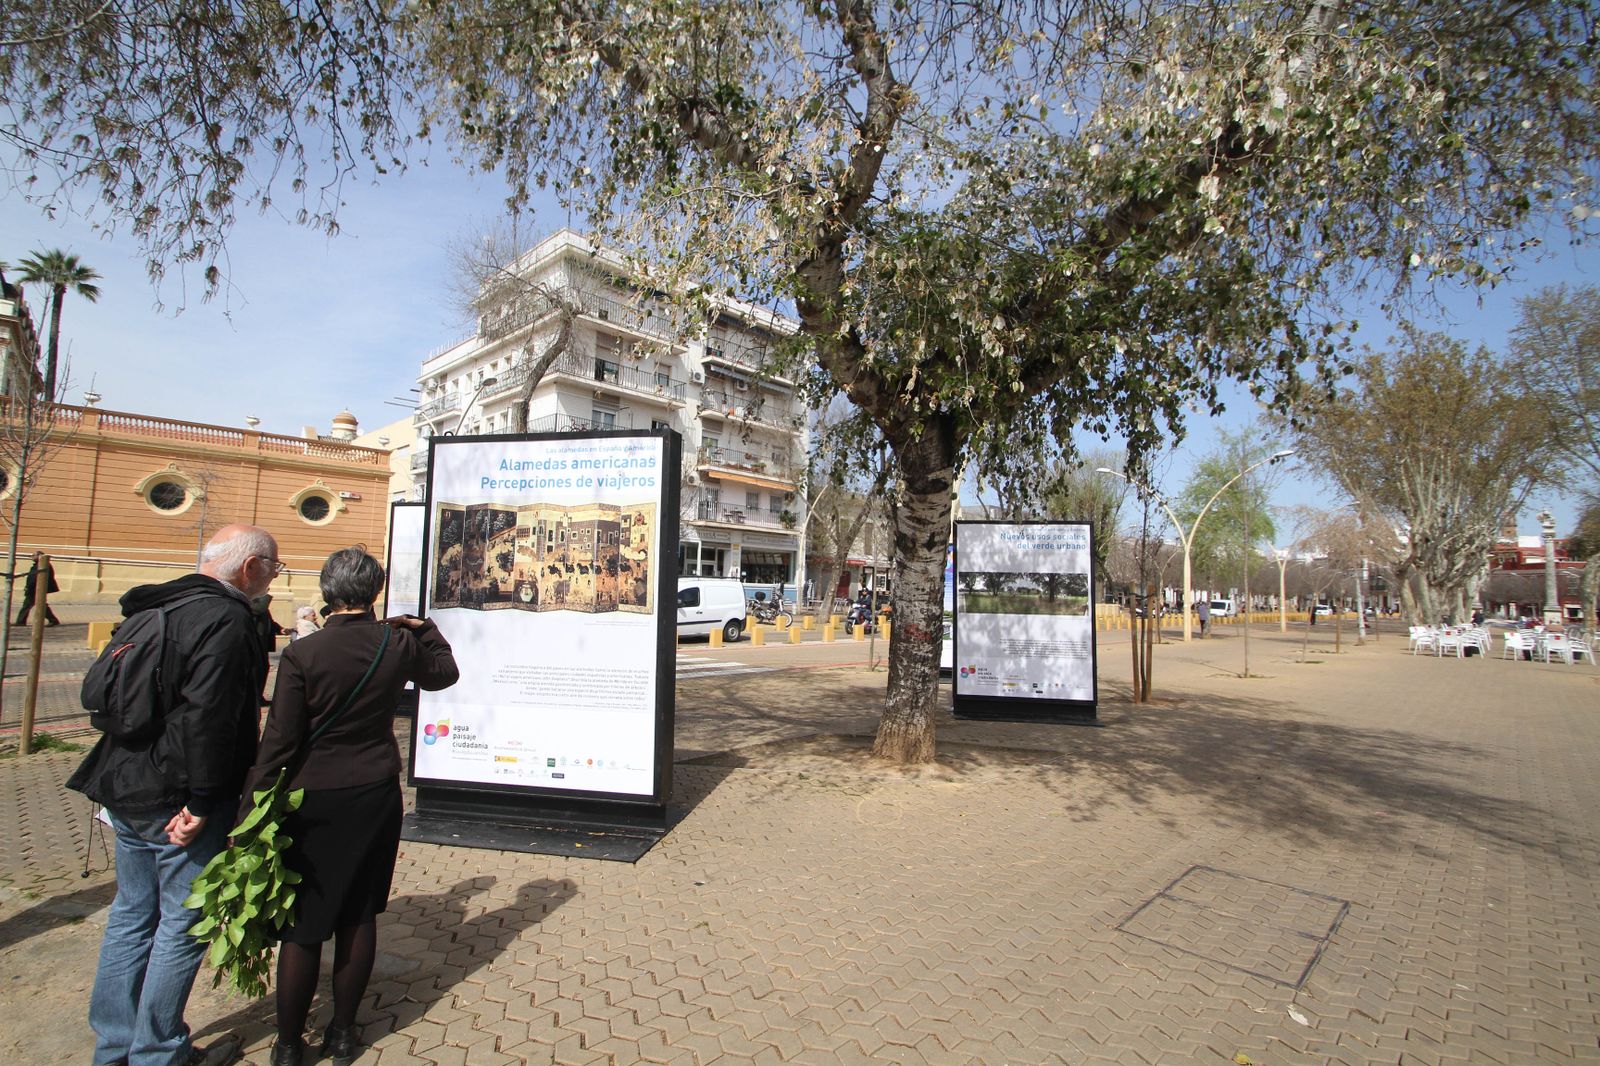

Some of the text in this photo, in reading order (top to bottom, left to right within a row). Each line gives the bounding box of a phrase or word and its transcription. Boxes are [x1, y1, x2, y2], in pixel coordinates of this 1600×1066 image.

[499, 456, 656, 471] Alamedas americanas
[480, 474, 656, 492] Percepciones de viajeros
[1000, 532, 1030, 541] Nuevos
[1052, 532, 1087, 541] sociales
[453, 724, 469, 733] agua
[452, 733, 477, 742] paisaje
